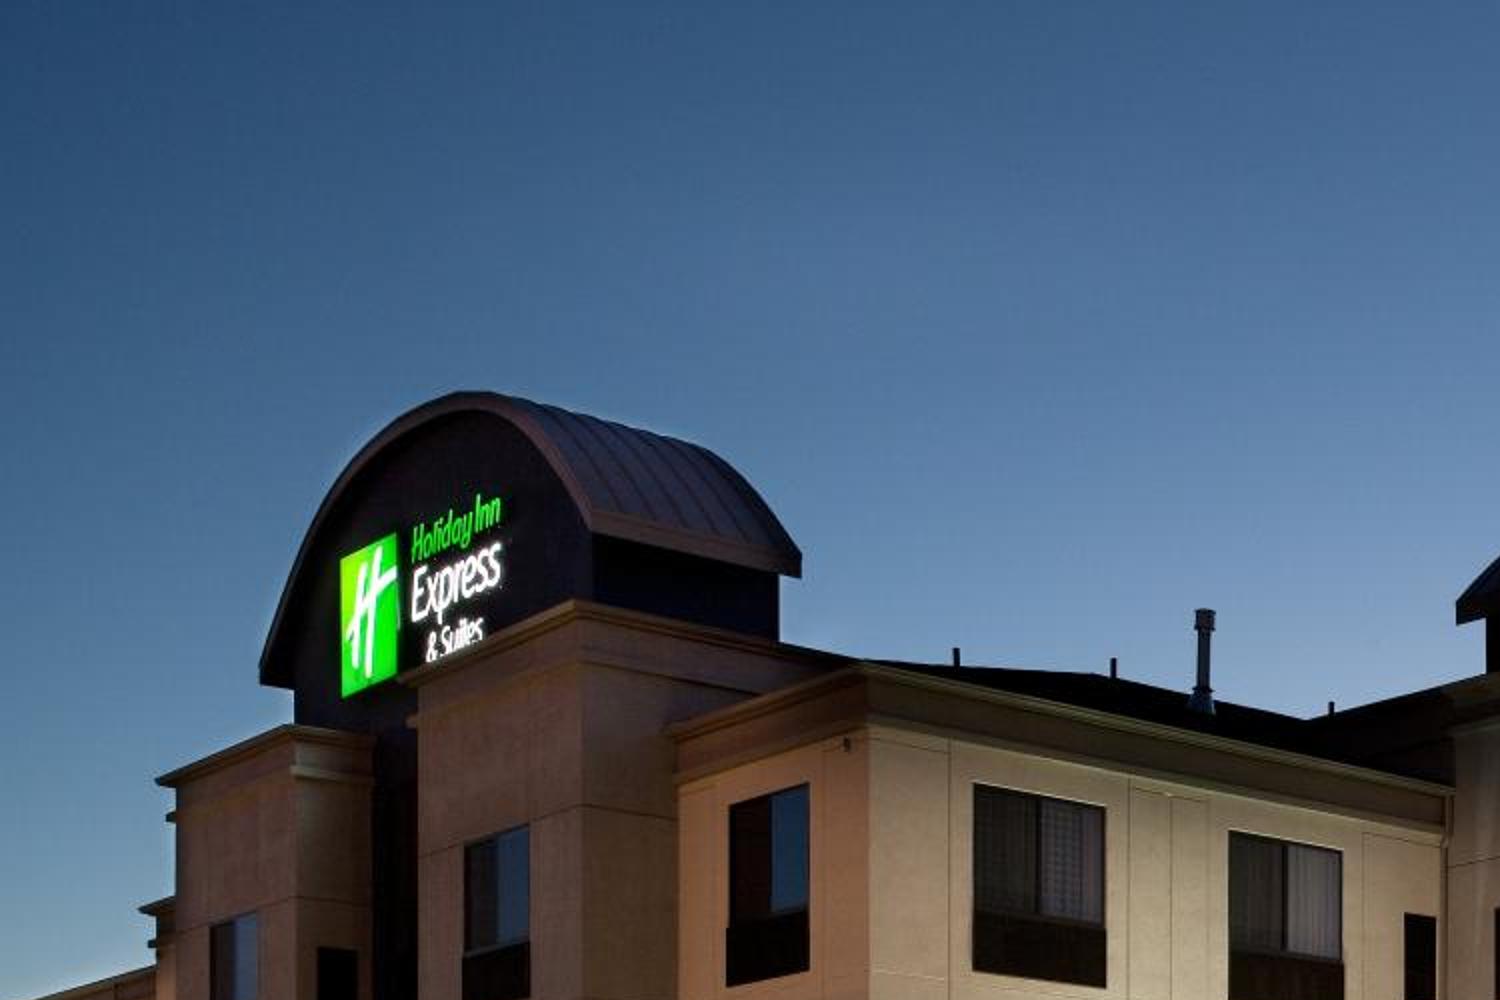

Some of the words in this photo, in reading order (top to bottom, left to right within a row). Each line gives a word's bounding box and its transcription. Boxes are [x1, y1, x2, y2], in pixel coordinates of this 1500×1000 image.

[411, 508, 474, 563] Holiday
[475, 493, 501, 533] Inn
[411, 542, 503, 624] Express
[425, 632, 437, 663] &
[441, 617, 484, 657] Suites
